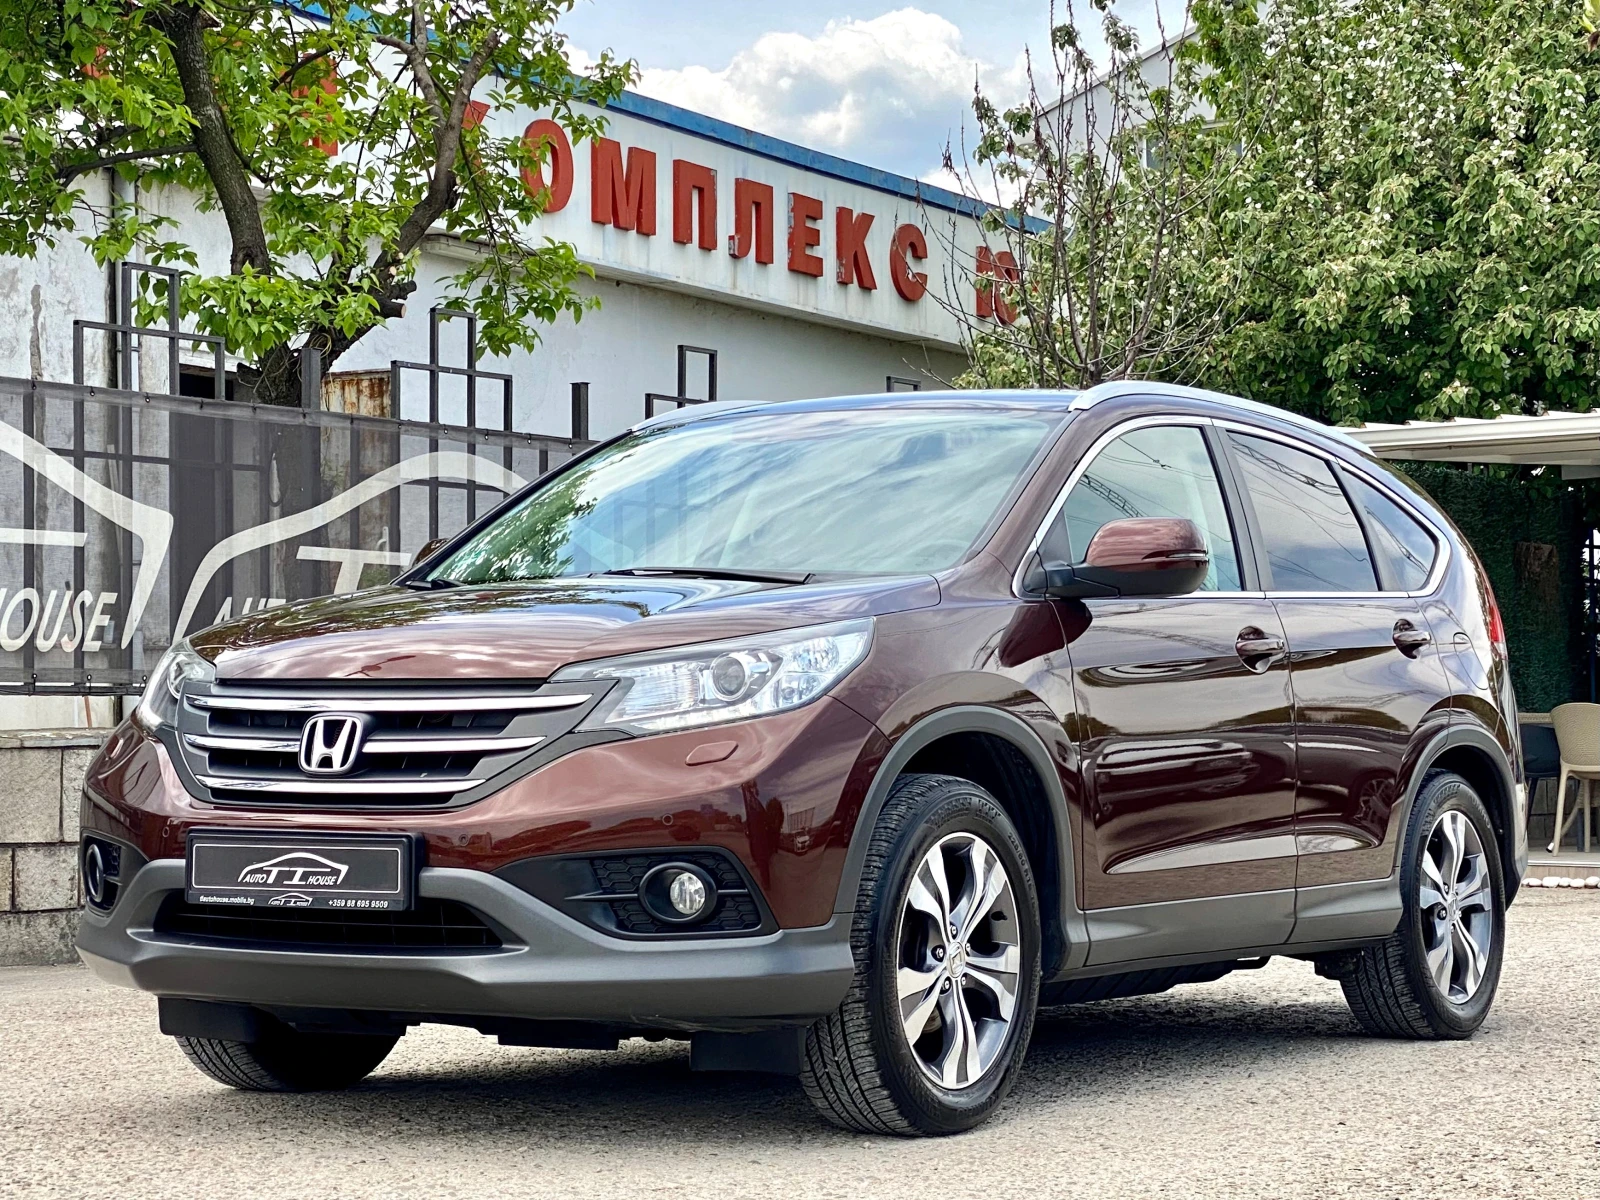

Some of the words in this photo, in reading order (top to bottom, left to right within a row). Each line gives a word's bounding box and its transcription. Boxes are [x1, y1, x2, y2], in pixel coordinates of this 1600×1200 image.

[455, 100, 928, 302] ОМПЛЕКС
[0, 587, 118, 653] OUSE
[243, 873, 267, 884] AUTO
[307, 875, 338, 886] HOUSE
